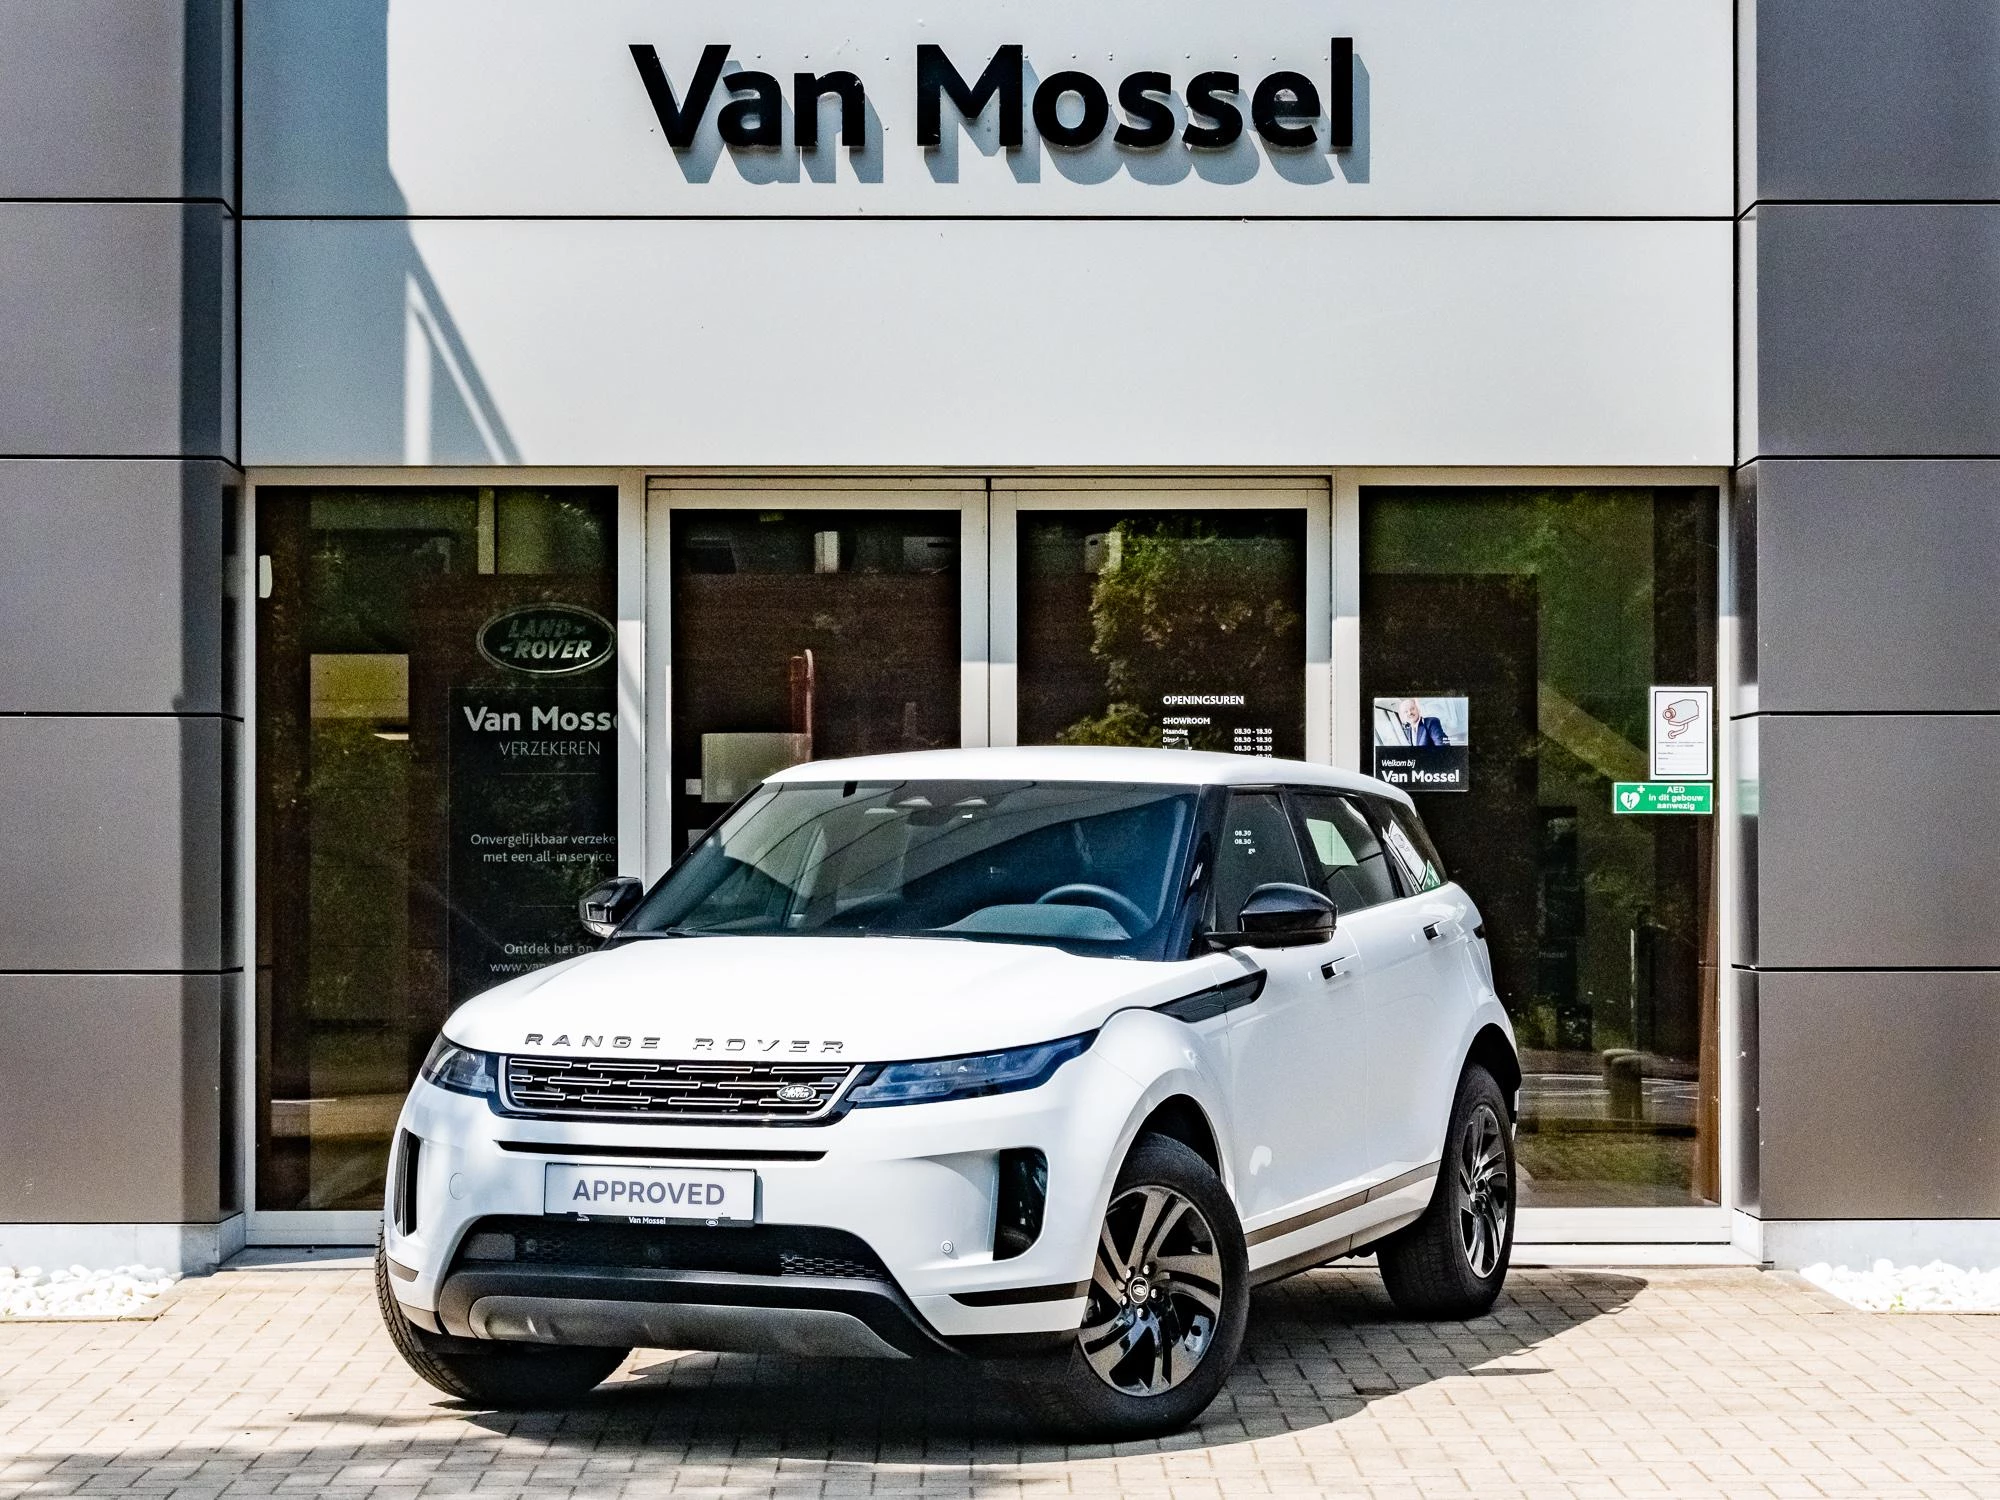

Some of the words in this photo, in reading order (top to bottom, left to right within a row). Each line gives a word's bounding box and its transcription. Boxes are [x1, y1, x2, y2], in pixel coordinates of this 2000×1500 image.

[628, 44, 866, 147] Van
[917, 36, 1354, 147] Mossel
[508, 619, 571, 637] LAND
[514, 640, 592, 658] ROVER
[1162, 695, 1244, 705] OPENINGSUREN
[463, 706, 521, 731] Van
[532, 706, 618, 731] Moss
[1162, 717, 1211, 725] SHOWROOM
[1162, 728, 1189, 736] Maandag
[500, 741, 600, 756] VERZEKEREN
[1407, 760, 1416, 768] bij
[1381, 770, 1408, 783] Van
[1411, 769, 1460, 783] Mossel
[1666, 786, 1686, 794] AED
[1648, 793, 1657, 801] in
[1658, 793, 1670, 801] dit
[1671, 793, 1705, 803] gebouw
[1656, 802, 1696, 811] aanwezig
[470, 833, 567, 848] Onvergelijkbaar
[572, 833, 616, 845] verzeke
[483, 852, 507, 862] met
[511, 853, 533, 862] een
[536, 851, 568, 862] all-in
[504, 943, 550, 955] Ontdek
[554, 943, 574, 954] het
[524, 1033, 661, 1049] RANGE
[692, 1038, 844, 1054] ROVER
[572, 1179, 725, 1206] APPROVED
[628, 1216, 642, 1224] Van
[643, 1217, 666, 1225] Mossel
